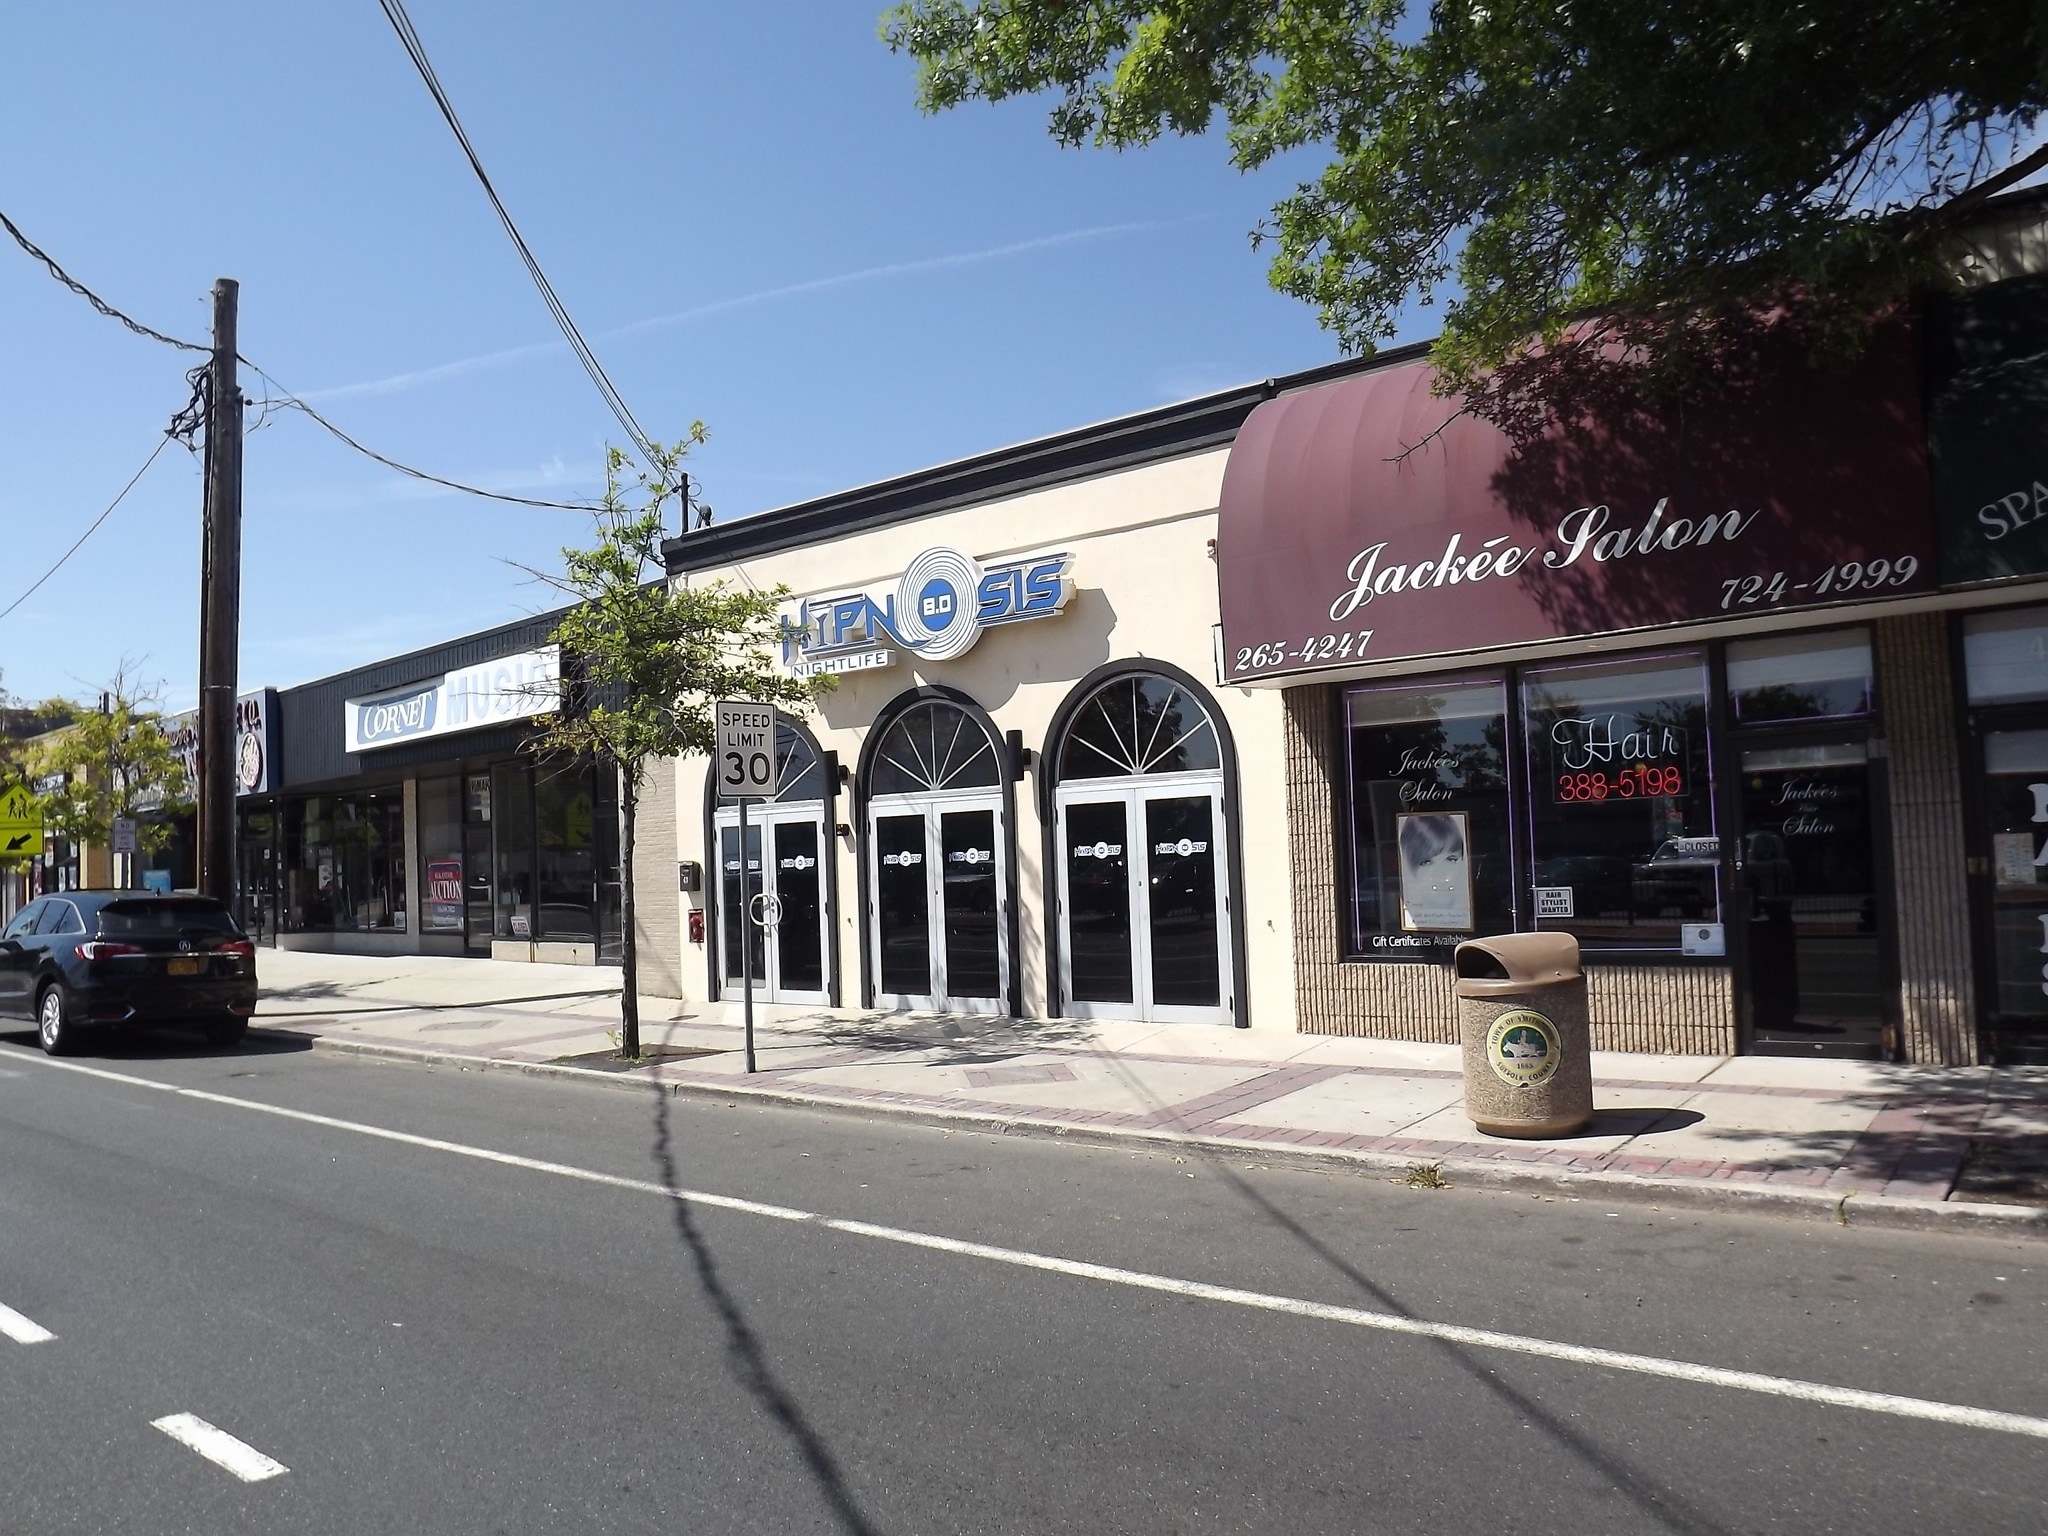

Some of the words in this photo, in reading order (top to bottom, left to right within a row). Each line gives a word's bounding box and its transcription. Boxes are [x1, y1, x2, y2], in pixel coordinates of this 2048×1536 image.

[1542, 497, 1760, 568] Salon
[1720, 555, 1918, 610] 724-1999
[1233, 629, 1376, 672] 265-4247
[793, 651, 887, 678] NIGHTLIFE
[363, 691, 433, 739] CORNET
[446, 656, 548, 726] MUSIC
[722, 712, 770, 728] SPEED
[727, 732, 765, 747] LIMIT
[1552, 715, 1678, 769] Hair
[725, 751, 770, 785] 30
[1399, 778, 1453, 802] Salon
[1559, 766, 1681, 801] 388-5198
[1782, 815, 1835, 836] Salon
[1685, 841, 1720, 852] CLOSED
[430, 880, 462, 900] AUCTION
[1372, 935, 1387, 947] Gift
[1388, 935, 1432, 947] Certificates
[1491, 1026, 1504, 1045] TOWN
[1496, 1061, 1523, 1080] SUFFOLK
[1528, 1061, 1553, 1081] COUNTY
